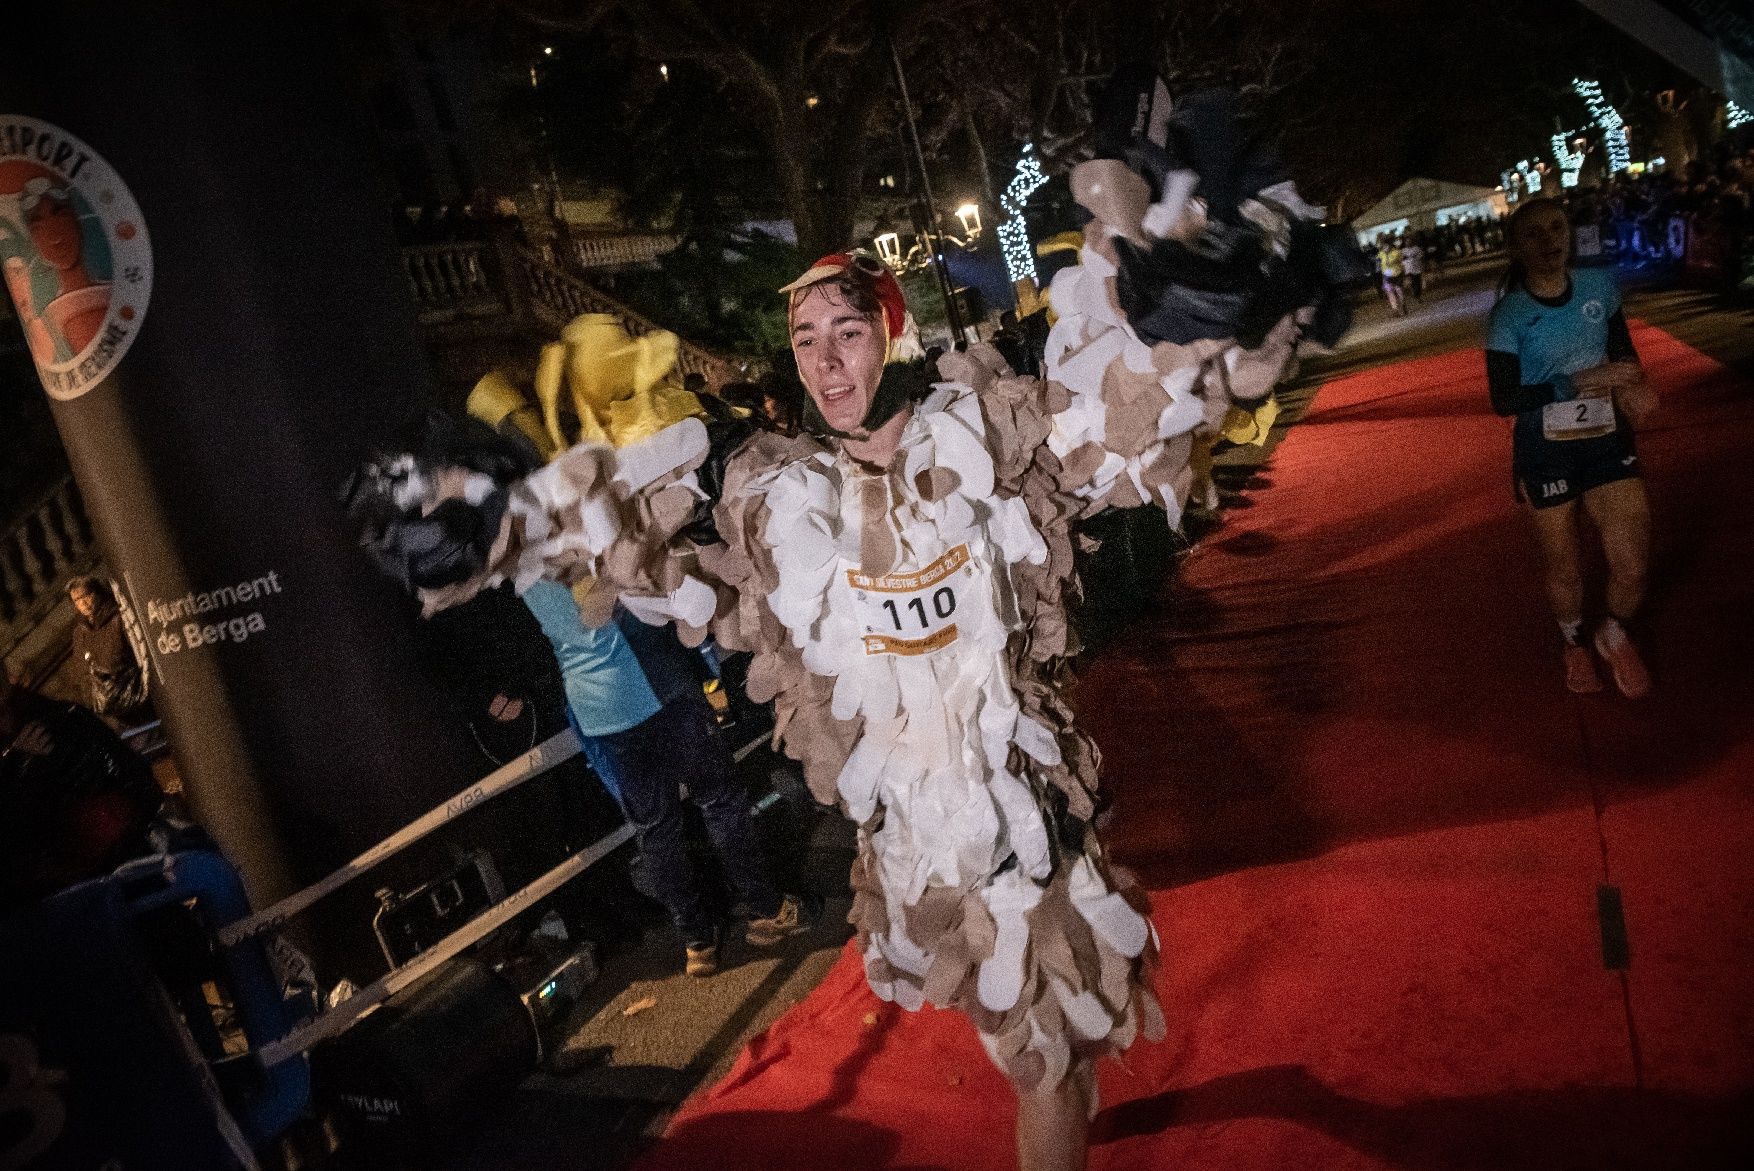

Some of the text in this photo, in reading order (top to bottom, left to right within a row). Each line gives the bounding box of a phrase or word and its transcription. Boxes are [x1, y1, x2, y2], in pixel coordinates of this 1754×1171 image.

[1576, 403, 1587, 422] 2
[147, 571, 282, 628] Ajuntament
[883, 587, 956, 630] 110
[157, 611, 268, 656] de Berga
